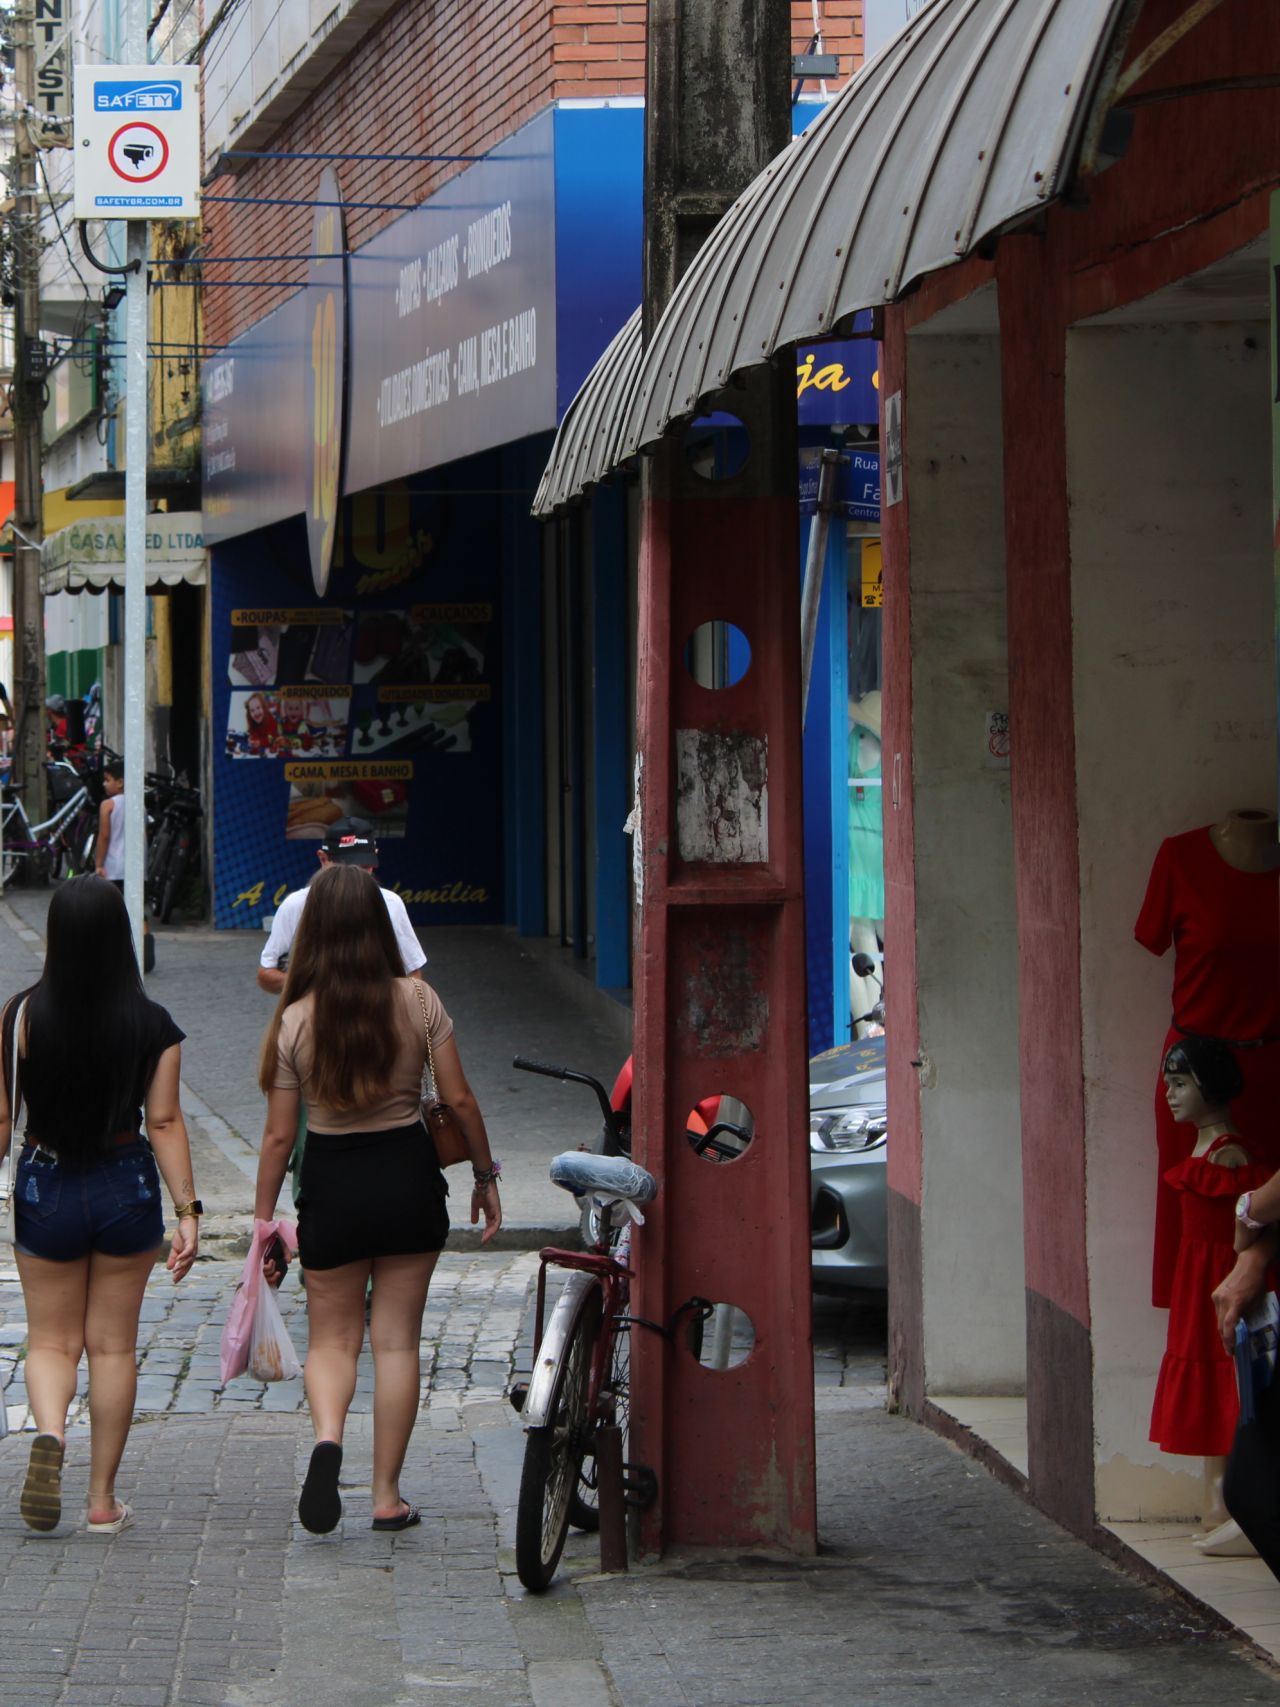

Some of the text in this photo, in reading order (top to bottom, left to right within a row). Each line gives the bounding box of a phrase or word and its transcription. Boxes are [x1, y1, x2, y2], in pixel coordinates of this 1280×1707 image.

[97, 93, 172, 108] SAFETY
[97, 197, 180, 205] SAFETYBR.COM.BR
[427, 233, 459, 307] CALÇADOS
[468, 200, 511, 279] BRINQUEDOS
[458, 335, 480, 397] CAMA,
[481, 325, 501, 386] MESA
[502, 321, 508, 378] E
[509, 307, 536, 376] BANHO
[854, 457, 879, 471] Rua
[70, 534, 117, 550] CASA
[168, 534, 204, 549] LTDA
[241, 611, 287, 624] ROUPAS
[286, 687, 350, 698] BRINQUEDOS
[293, 765, 409, 779] CAMA, MESA E BANHO
